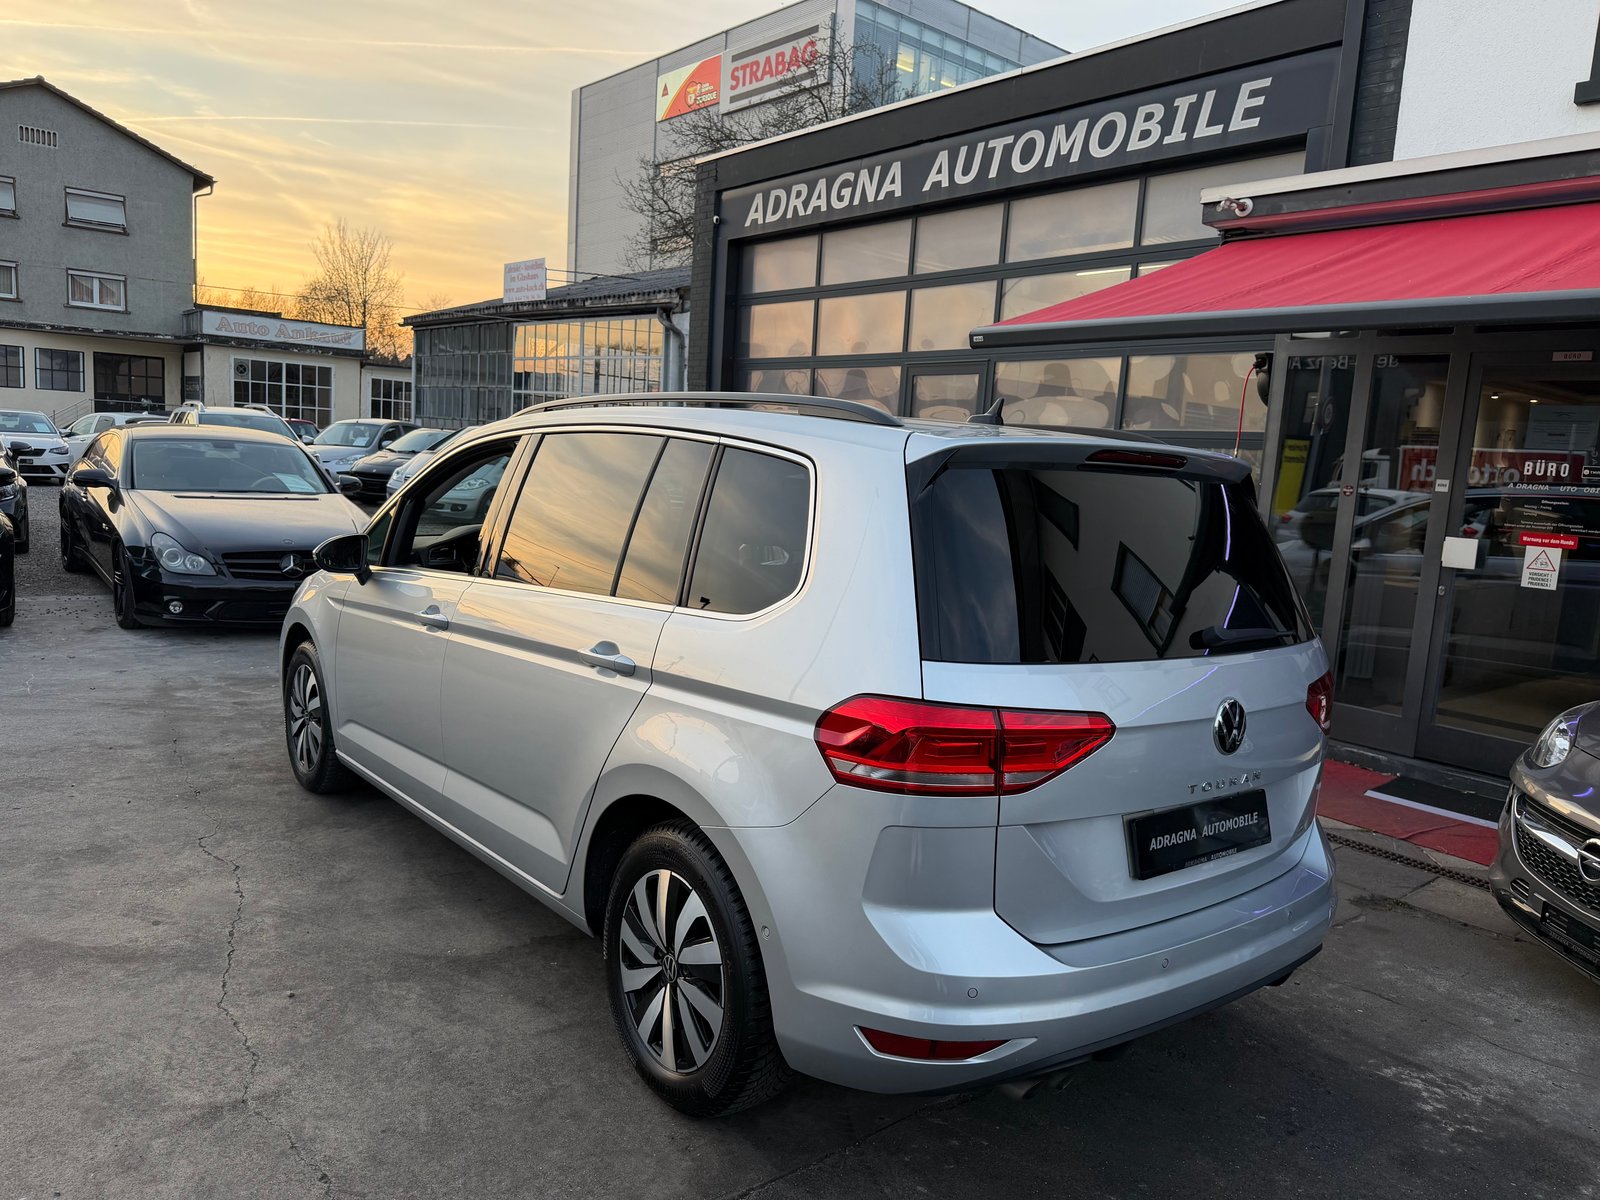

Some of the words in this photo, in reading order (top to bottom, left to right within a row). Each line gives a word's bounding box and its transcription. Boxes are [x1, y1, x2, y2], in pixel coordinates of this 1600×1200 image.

[730, 39, 817, 91] STRABAG
[744, 160, 902, 228] ADRAGNA
[921, 77, 1275, 192] AUTOMOBILE
[215, 316, 270, 336] Auto
[275, 323, 354, 346] Ankauf
[1523, 460, 1569, 477] BÜRO
[1187, 770, 1262, 794] TOURAN
[1150, 828, 1197, 851] ADRAGNA
[1201, 811, 1259, 838] AUTOMOBILE
